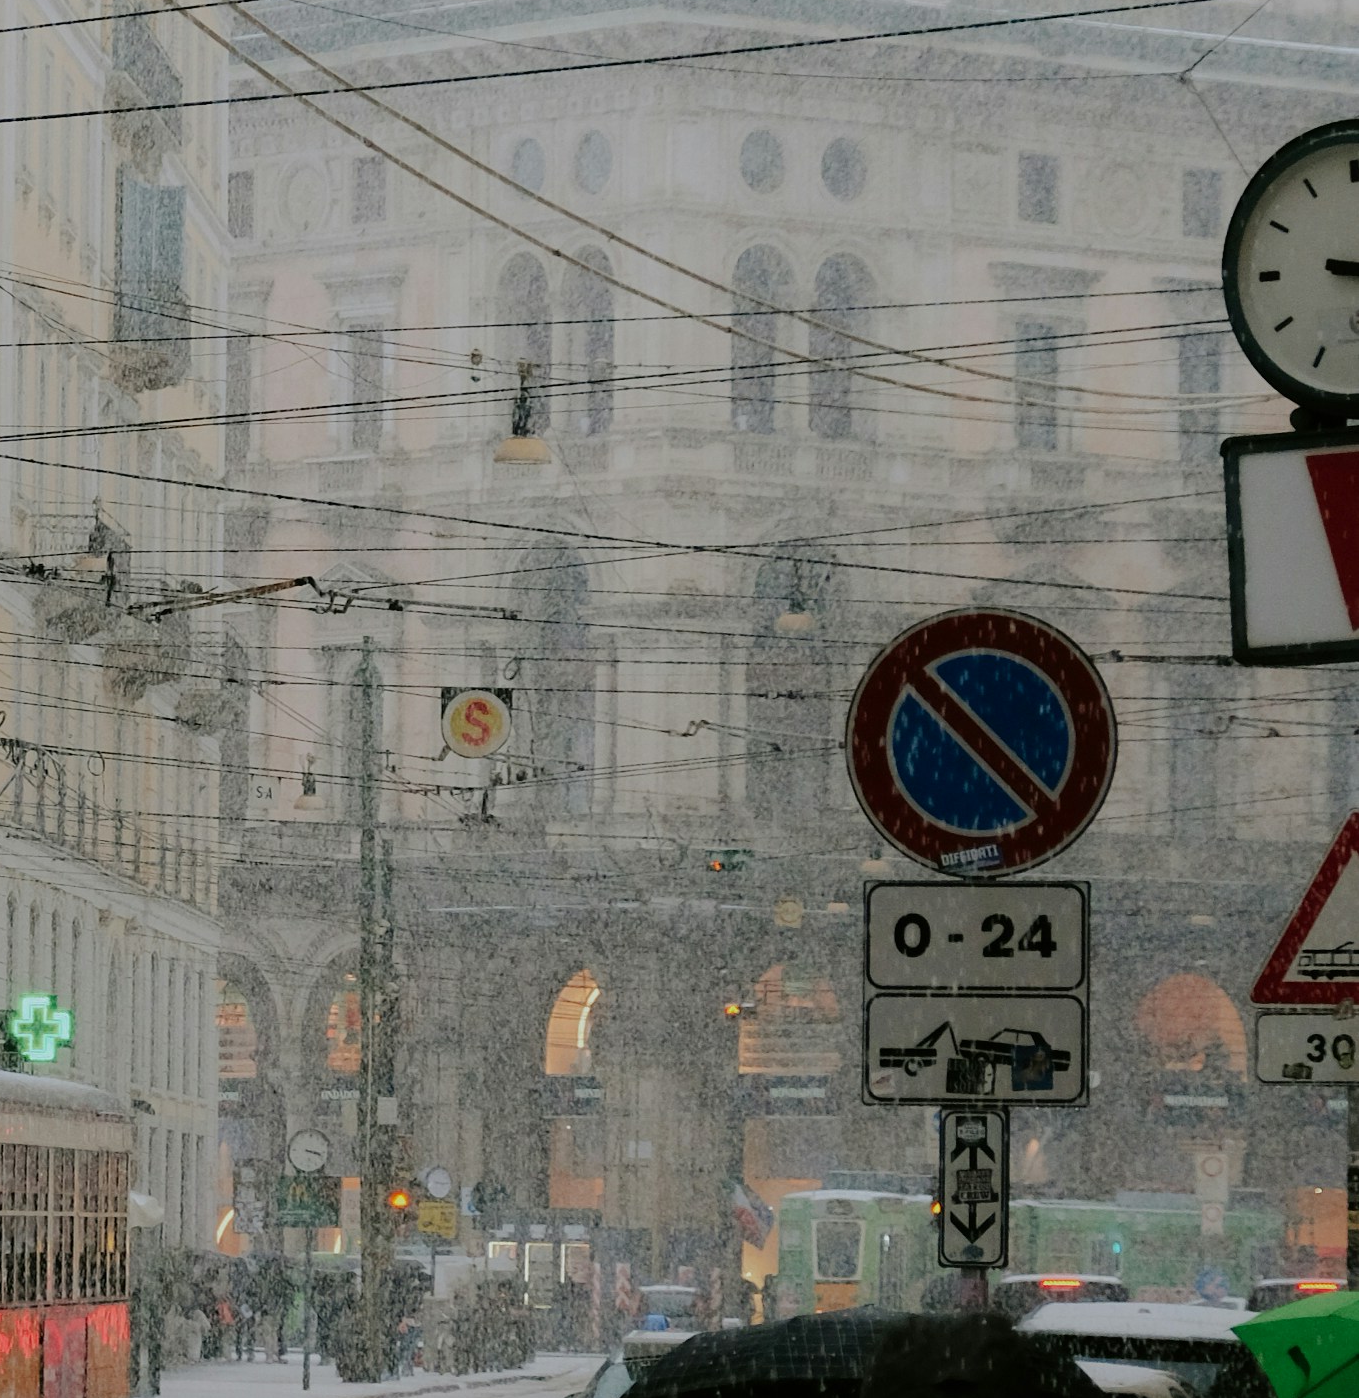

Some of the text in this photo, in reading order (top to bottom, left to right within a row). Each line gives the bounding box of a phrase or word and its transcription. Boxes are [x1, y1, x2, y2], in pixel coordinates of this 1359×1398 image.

[462, 701, 490, 746] S
[894, 913, 931, 958] 0
[981, 913, 1057, 959] 24
[1306, 1033, 1356, 1065] 30
